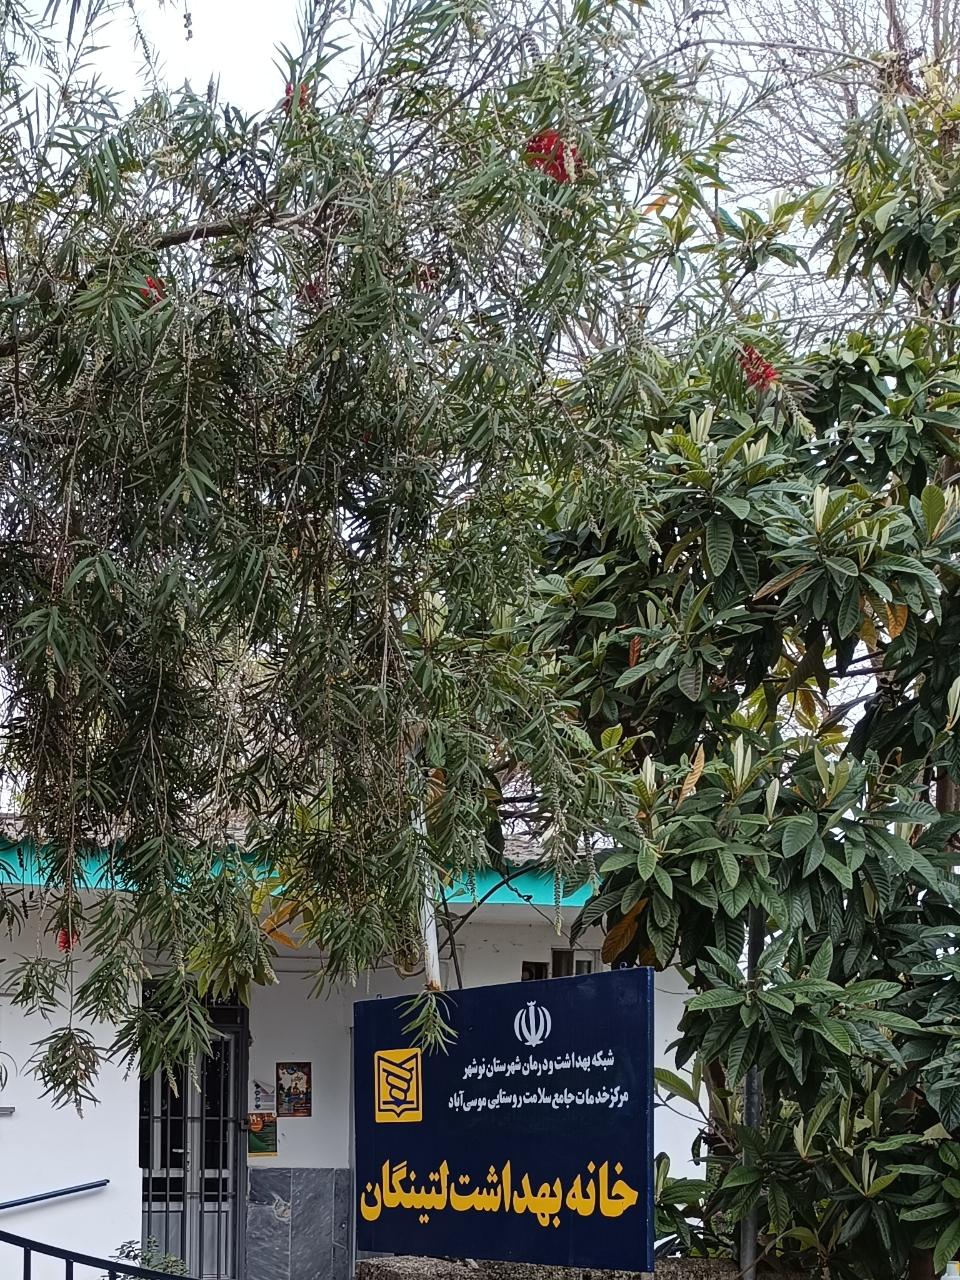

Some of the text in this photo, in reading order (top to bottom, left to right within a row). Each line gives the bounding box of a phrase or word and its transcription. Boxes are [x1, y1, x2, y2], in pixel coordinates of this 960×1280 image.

[462, 1057, 486, 1080] نوشهر
[486, 1055, 522, 1078] شهرستان
[554, 1051, 591, 1073] بهداشت
[591, 1049, 615, 1071] شبکه
[487, 1088, 523, 1110] روستایی
[522, 1087, 552, 1104] سلامت
[551, 1087, 576, 1109] جامع
[575, 1086, 610, 1105] خدمات
[608, 1085, 629, 1108] مرکز
[360, 1159, 639, 1228] خانه بهداشت لتینگان
